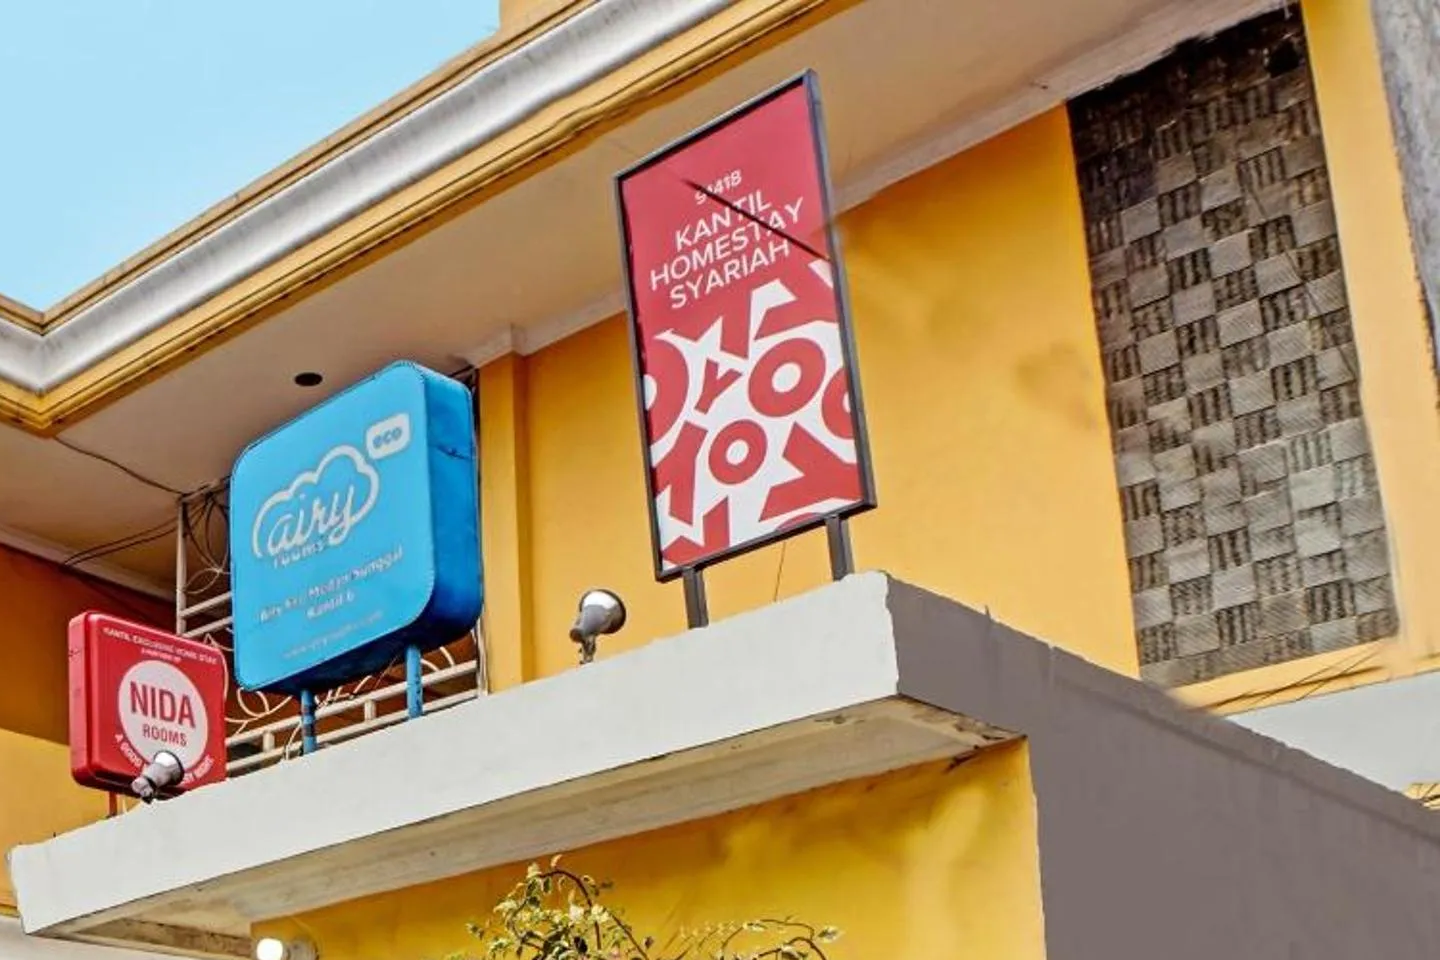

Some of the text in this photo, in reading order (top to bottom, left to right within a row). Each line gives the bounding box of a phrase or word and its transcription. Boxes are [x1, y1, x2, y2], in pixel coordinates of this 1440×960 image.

[650, 196, 804, 292] HOMESTAY
[676, 189, 772, 252] KANTIL
[670, 239, 790, 309] SYARIAH
[372, 427, 404, 449] eco
[267, 485, 356, 556] airy
[129, 680, 196, 729] NIDA
[142, 723, 188, 747] ROOMS
